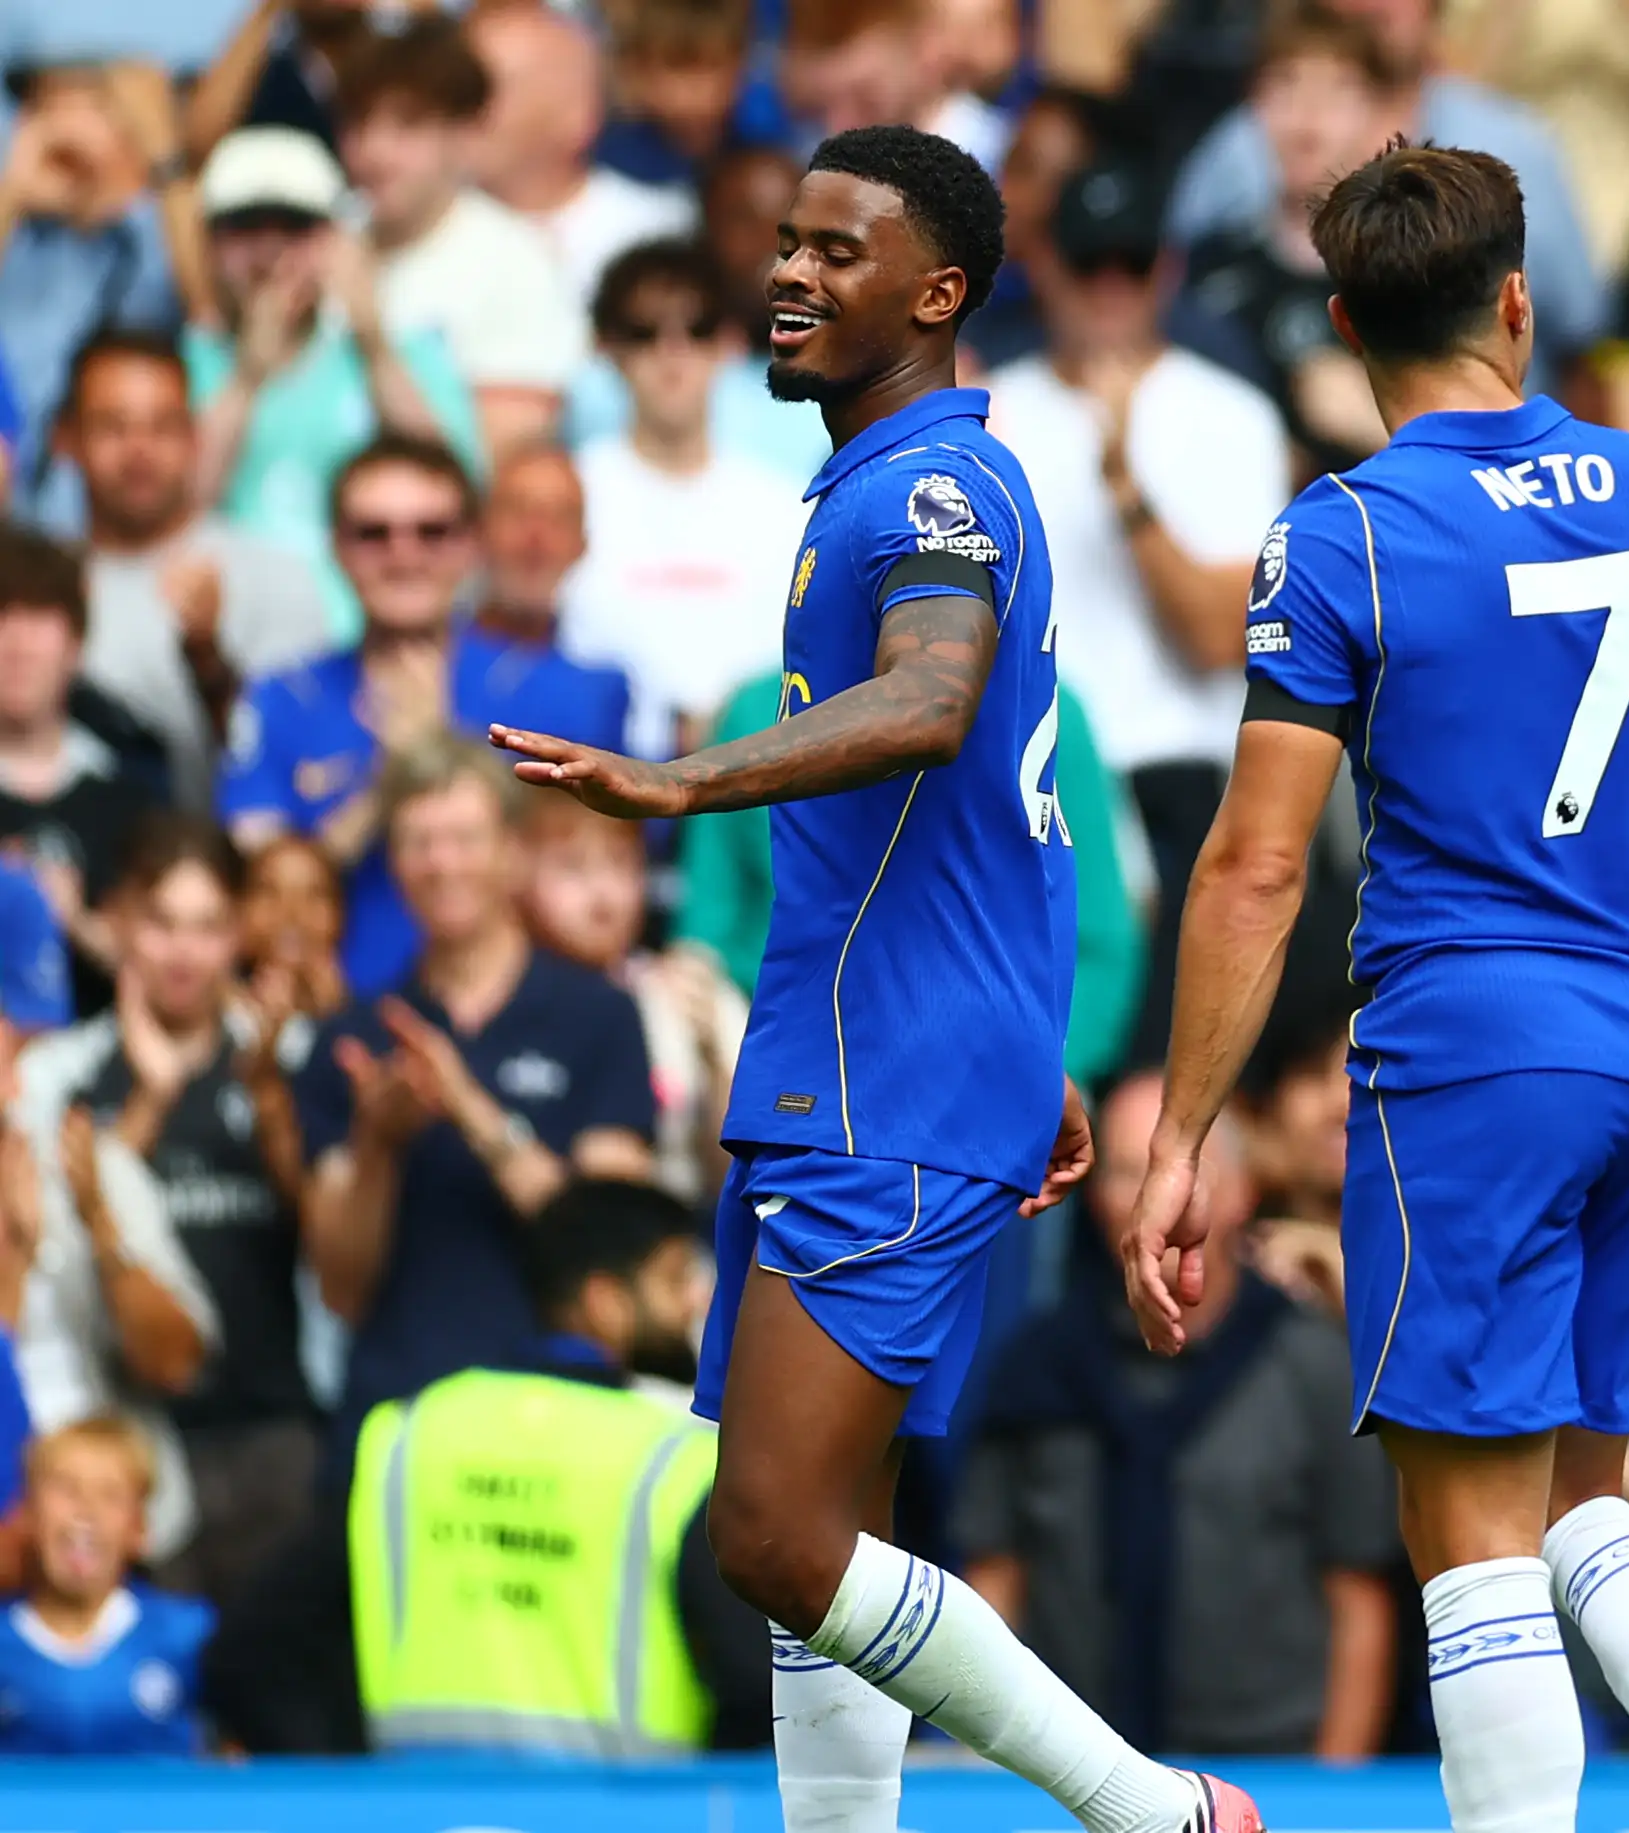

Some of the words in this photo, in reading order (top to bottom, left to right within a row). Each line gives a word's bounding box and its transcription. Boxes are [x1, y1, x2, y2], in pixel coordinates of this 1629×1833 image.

[1470, 453, 1615, 512] NETO
[916, 536, 946, 553] No
[946, 534, 994, 549] room
